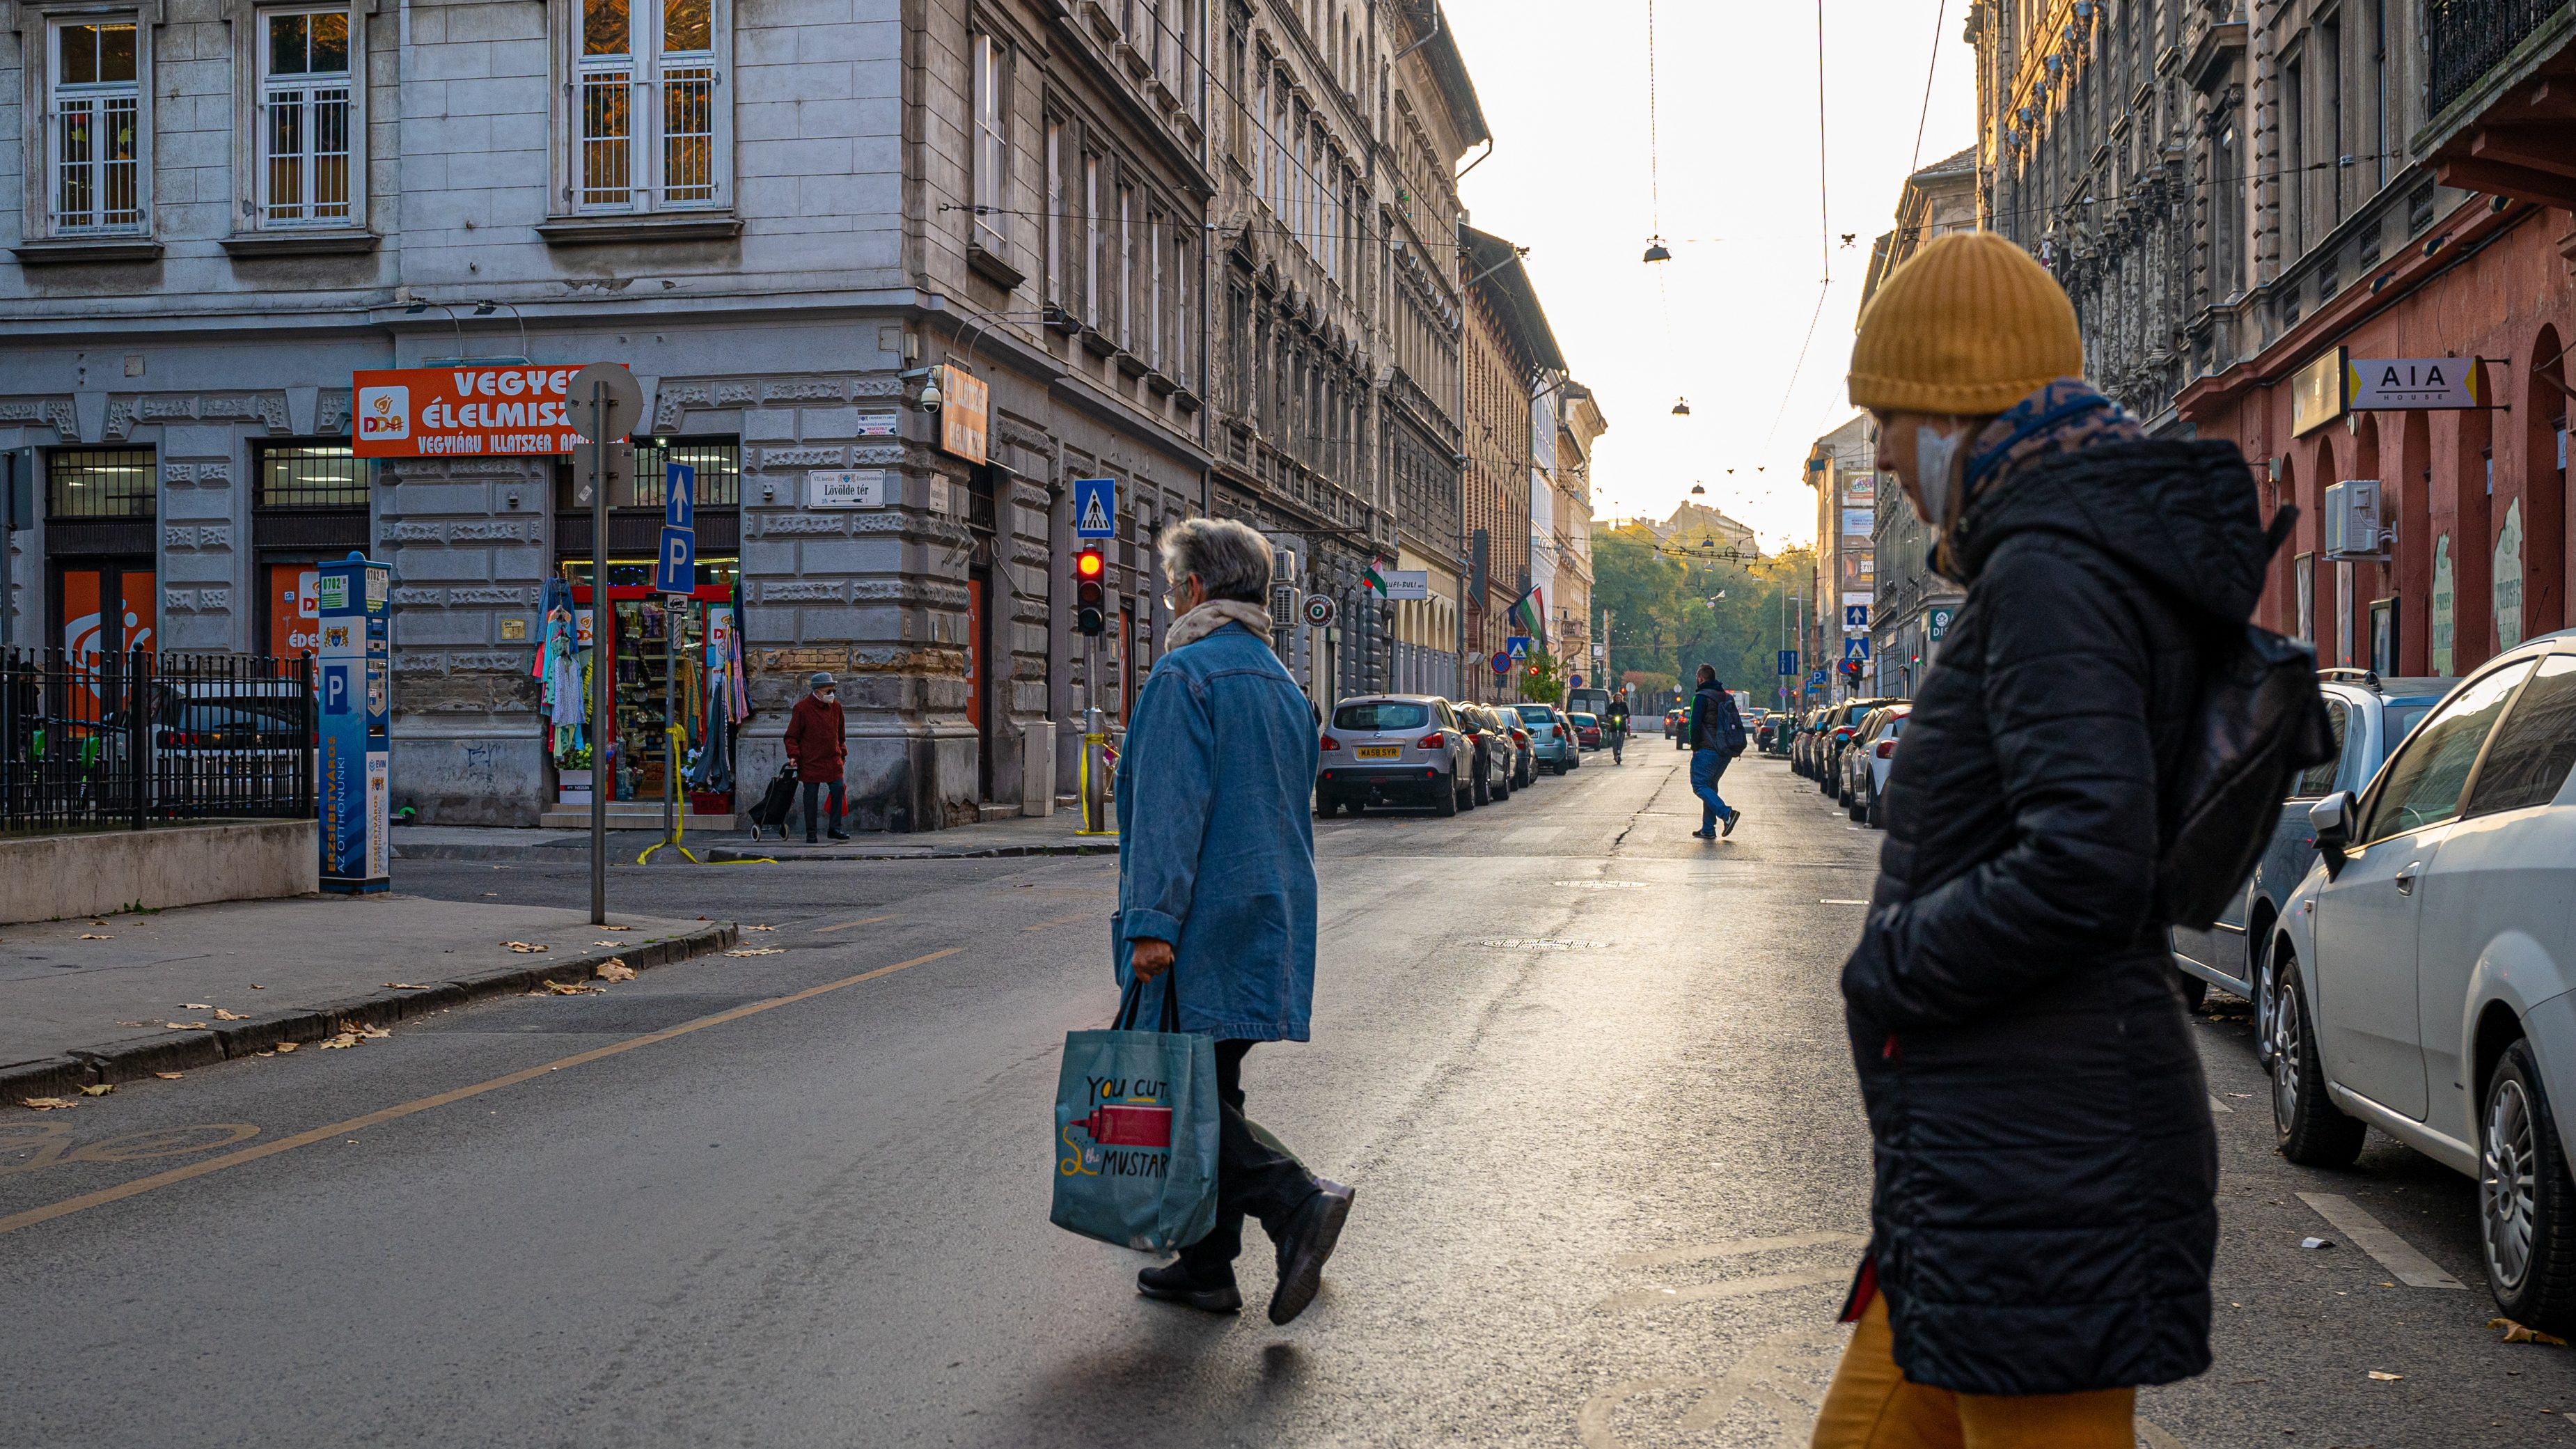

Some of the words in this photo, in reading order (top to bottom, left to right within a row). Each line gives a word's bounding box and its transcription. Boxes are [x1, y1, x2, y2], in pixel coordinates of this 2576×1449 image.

[2381, 366, 2445, 386] AIA
[418, 431, 482, 454] VEGYIÁRU
[490, 434, 551, 453] ILLATSZER
[824, 485, 855, 496] Lövölde
[857, 483, 869, 495] tér
[668, 538, 687, 583] P
[323, 577, 340, 590] 0702
[367, 569, 379, 581] 0702
[1814, 672, 1821, 682] P
[329, 675, 343, 706] P
[1361, 749, 1381, 757] MA58
[1383, 748, 1397, 756] SYR
[376, 760, 386, 768] EVIN
[327, 735, 336, 872] ERZSÉBETVÁROS
[337, 855, 345, 873] AZ
[1087, 1076, 1126, 1106] YOU
[1134, 1079, 1168, 1099] CUT
[1085, 1147, 1100, 1164] the
